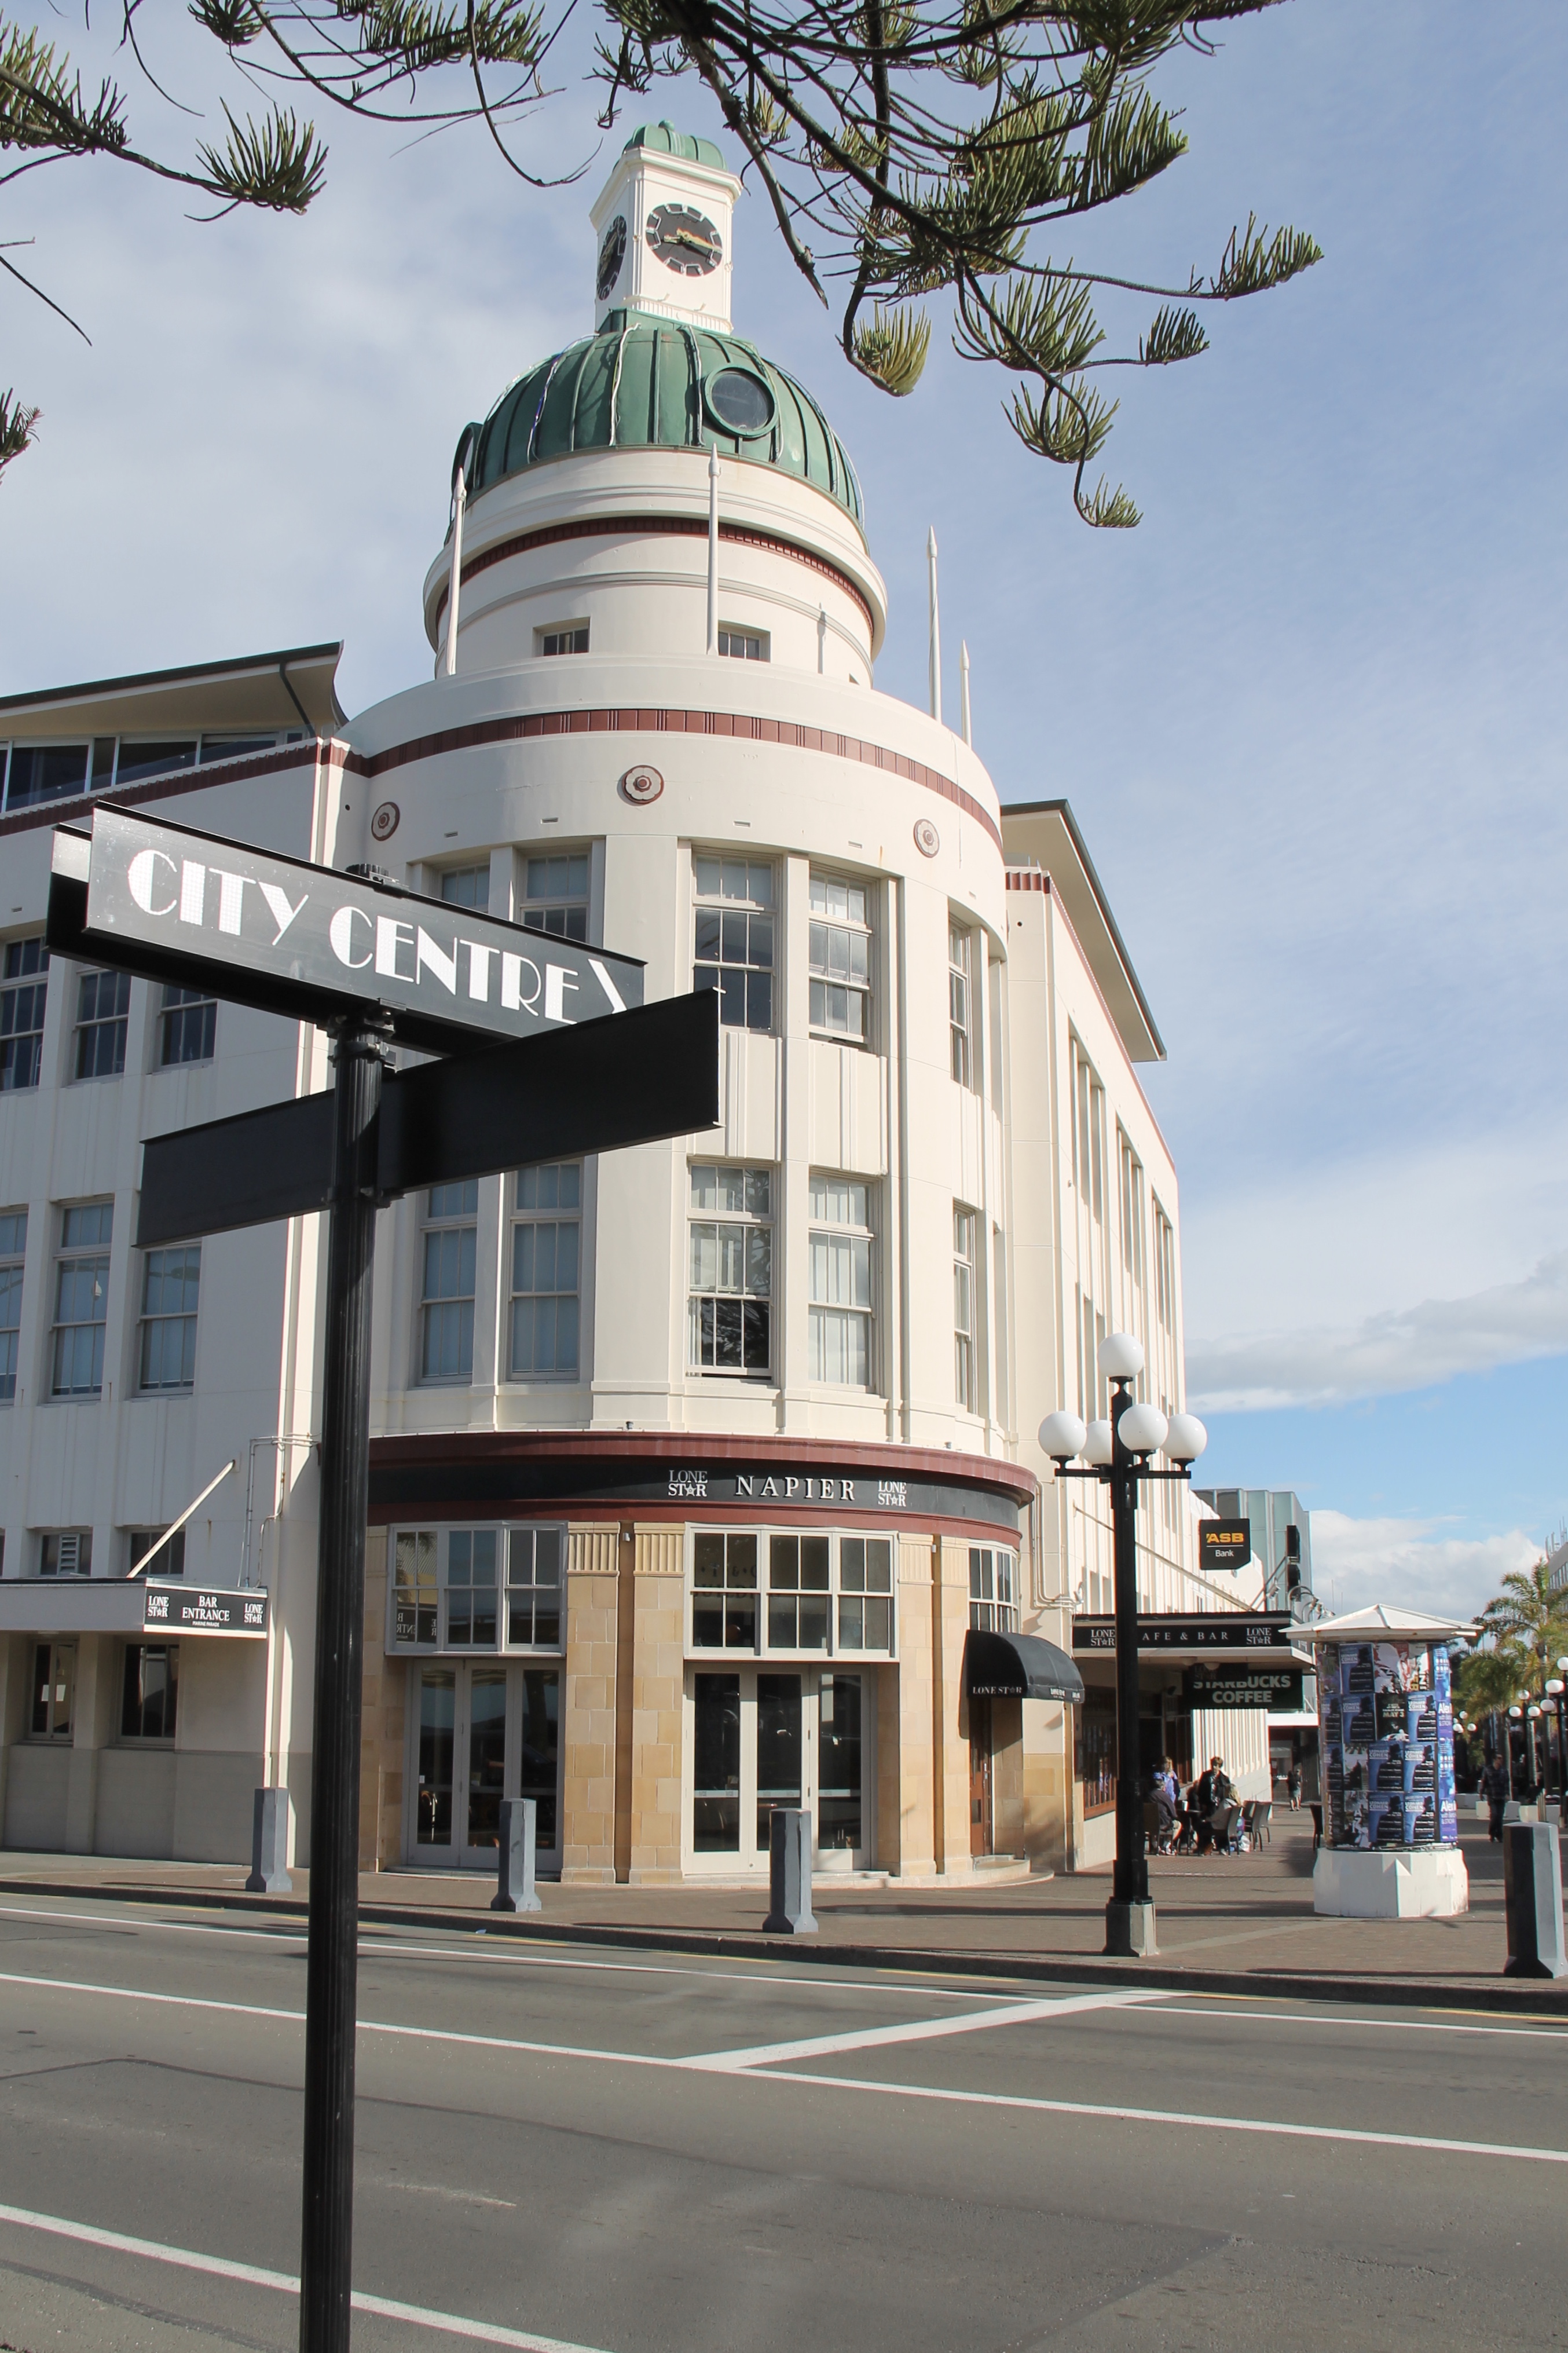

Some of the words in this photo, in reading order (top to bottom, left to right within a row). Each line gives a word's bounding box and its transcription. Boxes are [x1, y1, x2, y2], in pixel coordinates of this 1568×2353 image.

[128, 850, 309, 946] CITY
[329, 906, 578, 1024] CENTRE
[669, 1469, 708, 1484] LONE
[735, 1475, 855, 1501] NAPIER
[878, 1480, 907, 1494] LONE
[1206, 1532, 1244, 1543] ASB
[1215, 1549, 1234, 1557] Bank
[148, 1595, 169, 1607] LONE
[198, 1595, 218, 1608] BAR
[181, 1607, 230, 1622] ENTRANCE
[244, 1603, 263, 1614] LONE
[1091, 1629, 1115, 1638] LONE
[1142, 1632, 1171, 1641] AFE
[1180, 1632, 1188, 1640] &
[1198, 1632, 1229, 1640] BAR
[1246, 1627, 1272, 1636] LONE
[973, 1686, 997, 1695] LONE
[1212, 1690, 1273, 1703] COFFEE
